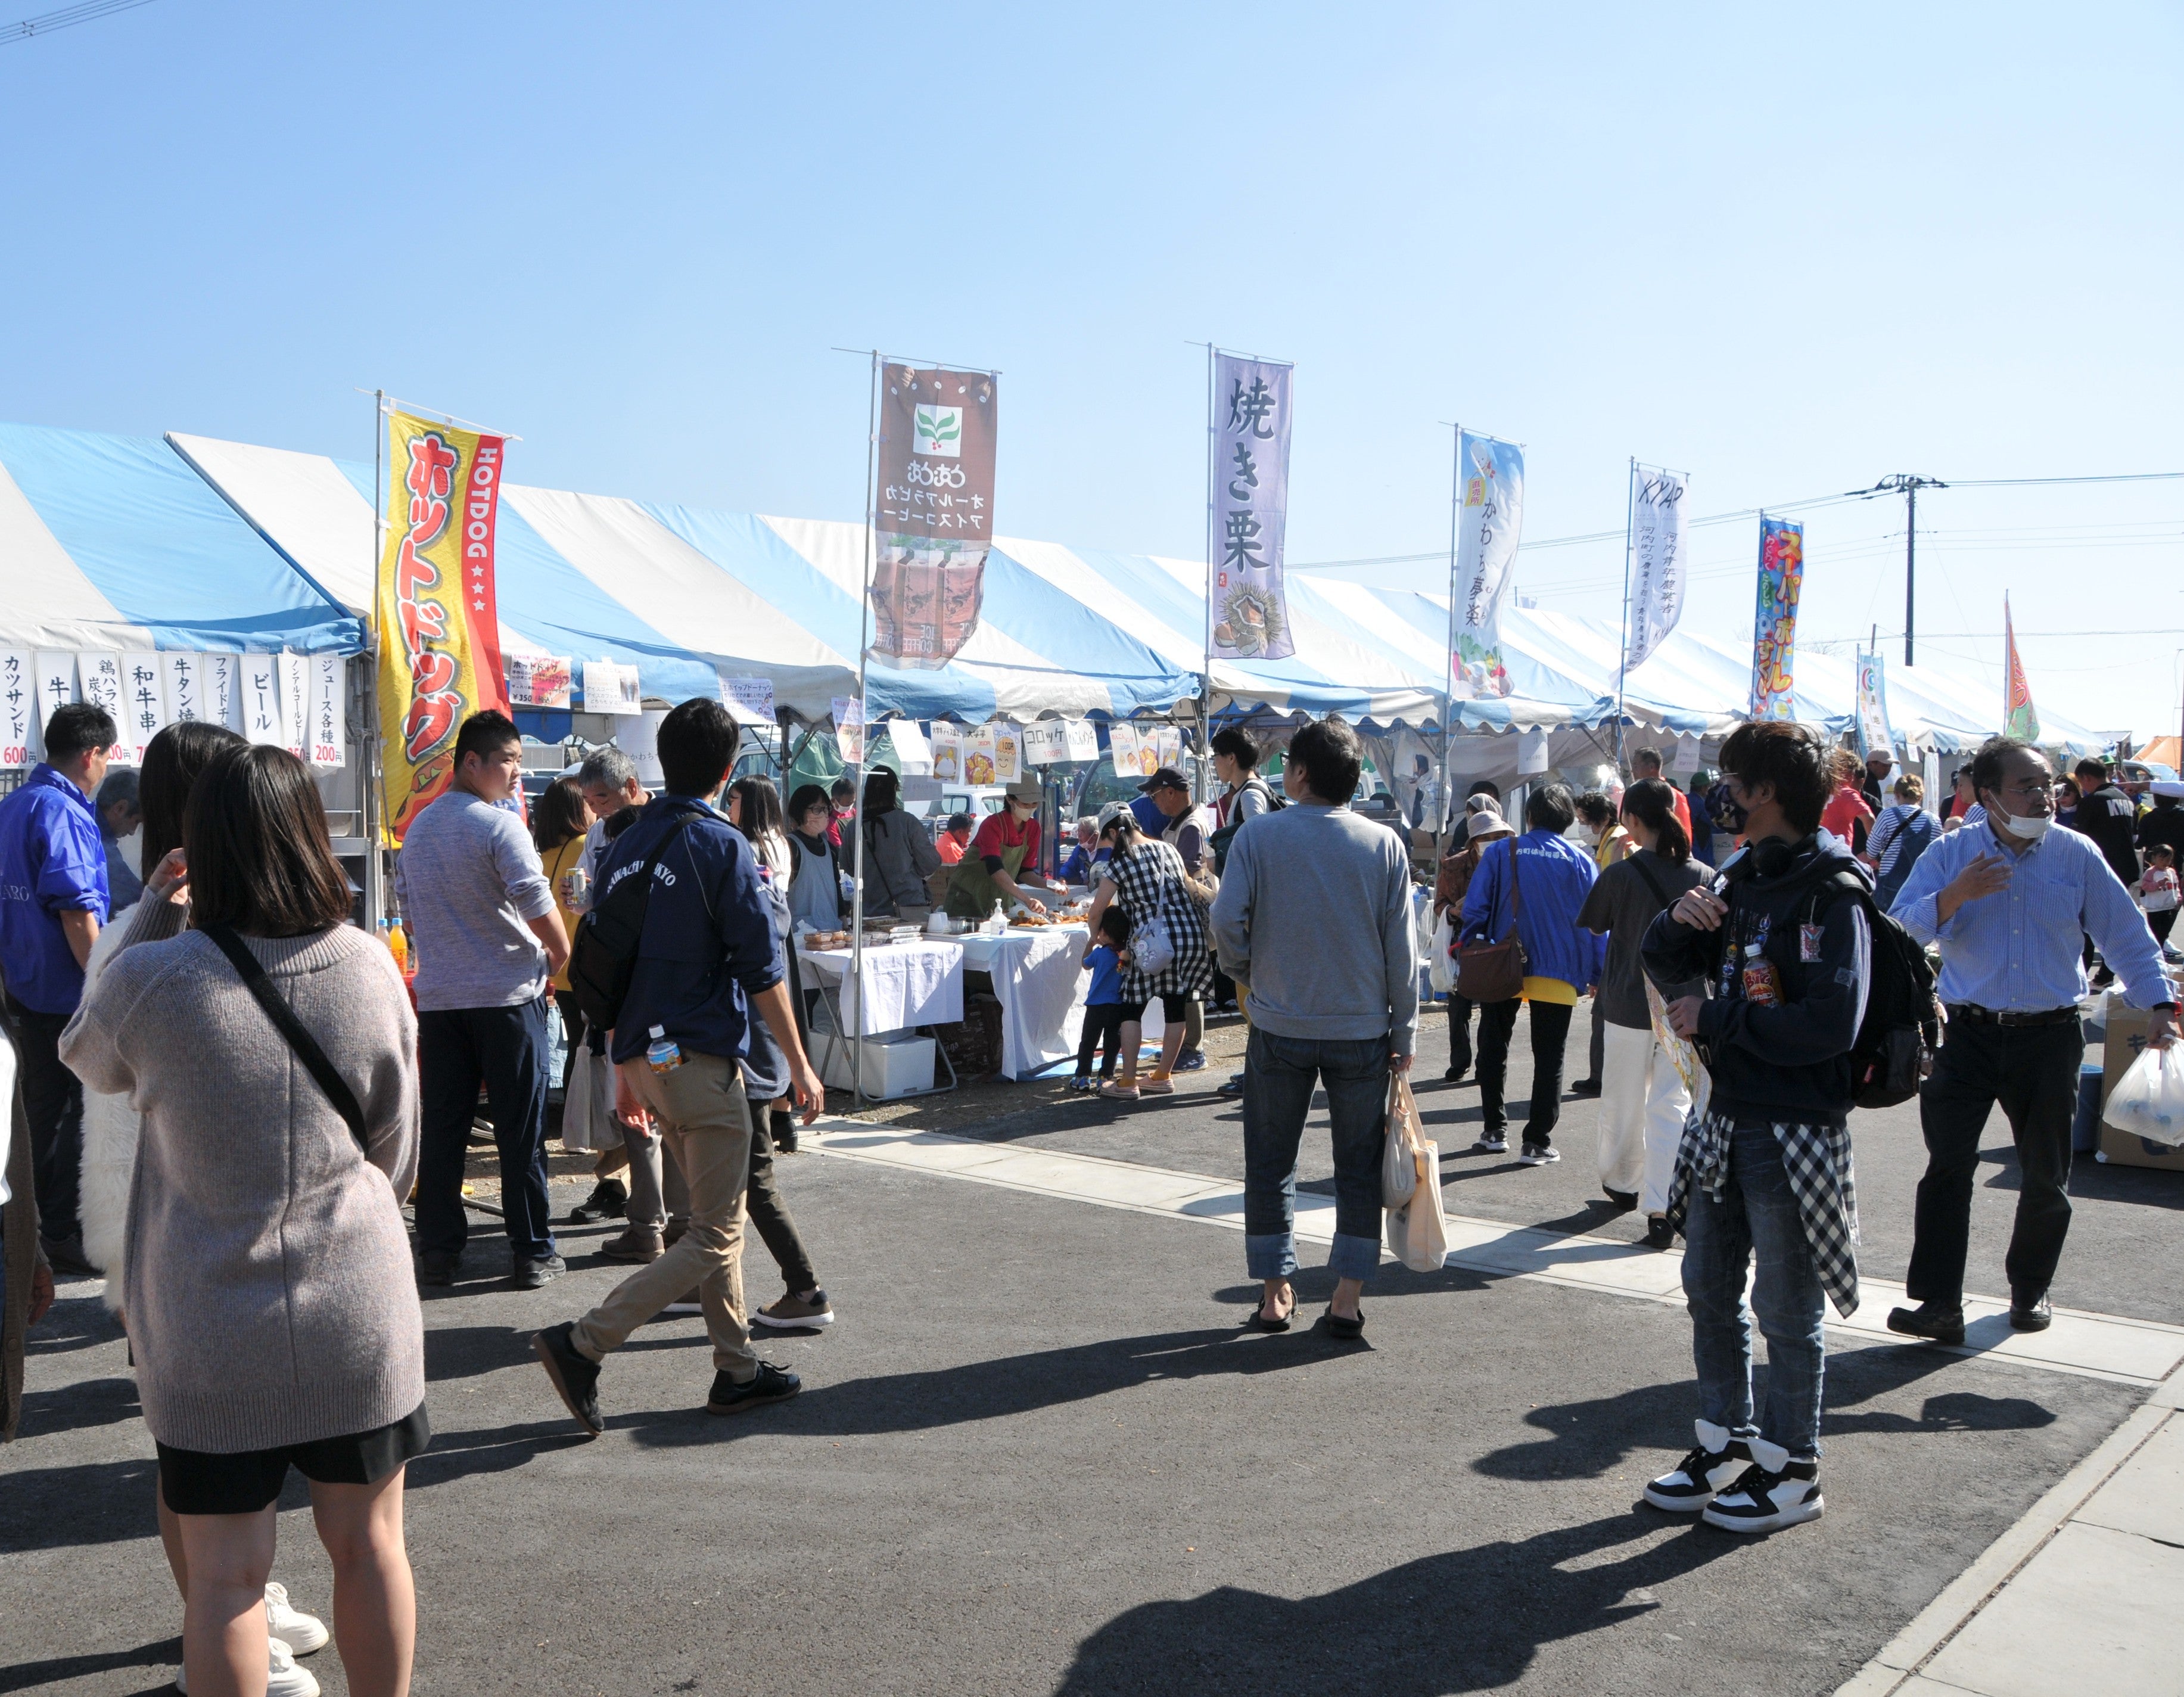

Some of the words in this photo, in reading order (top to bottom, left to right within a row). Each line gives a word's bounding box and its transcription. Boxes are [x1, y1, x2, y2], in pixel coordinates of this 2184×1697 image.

[467, 448, 498, 558] HOTDOG
[1222, 376, 1276, 573] 焼き栗
[1470, 481, 1481, 505] 直売所
[1638, 479, 1684, 509] KYAP
[1466, 498, 1497, 627] かわち夢楽
[397, 433, 459, 763] ホットドッグ
[4, 656, 24, 739] カツサンド
[99, 660, 117, 716] 鶏ハラミ
[132, 666, 157, 733] 和牛串
[254, 673, 272, 731] ビール
[291, 660, 303, 745] ノンアルコールビール
[321, 660, 334, 744] ジュース各種
[512, 694, 532, 702] ¥350
[4, 747, 37, 764] 600円
[315, 745, 342, 762] 200円
[630, 752, 658, 762] かわち
[1025, 728, 1064, 745] コロッケ
[1044, 748, 1063, 757] 100円
